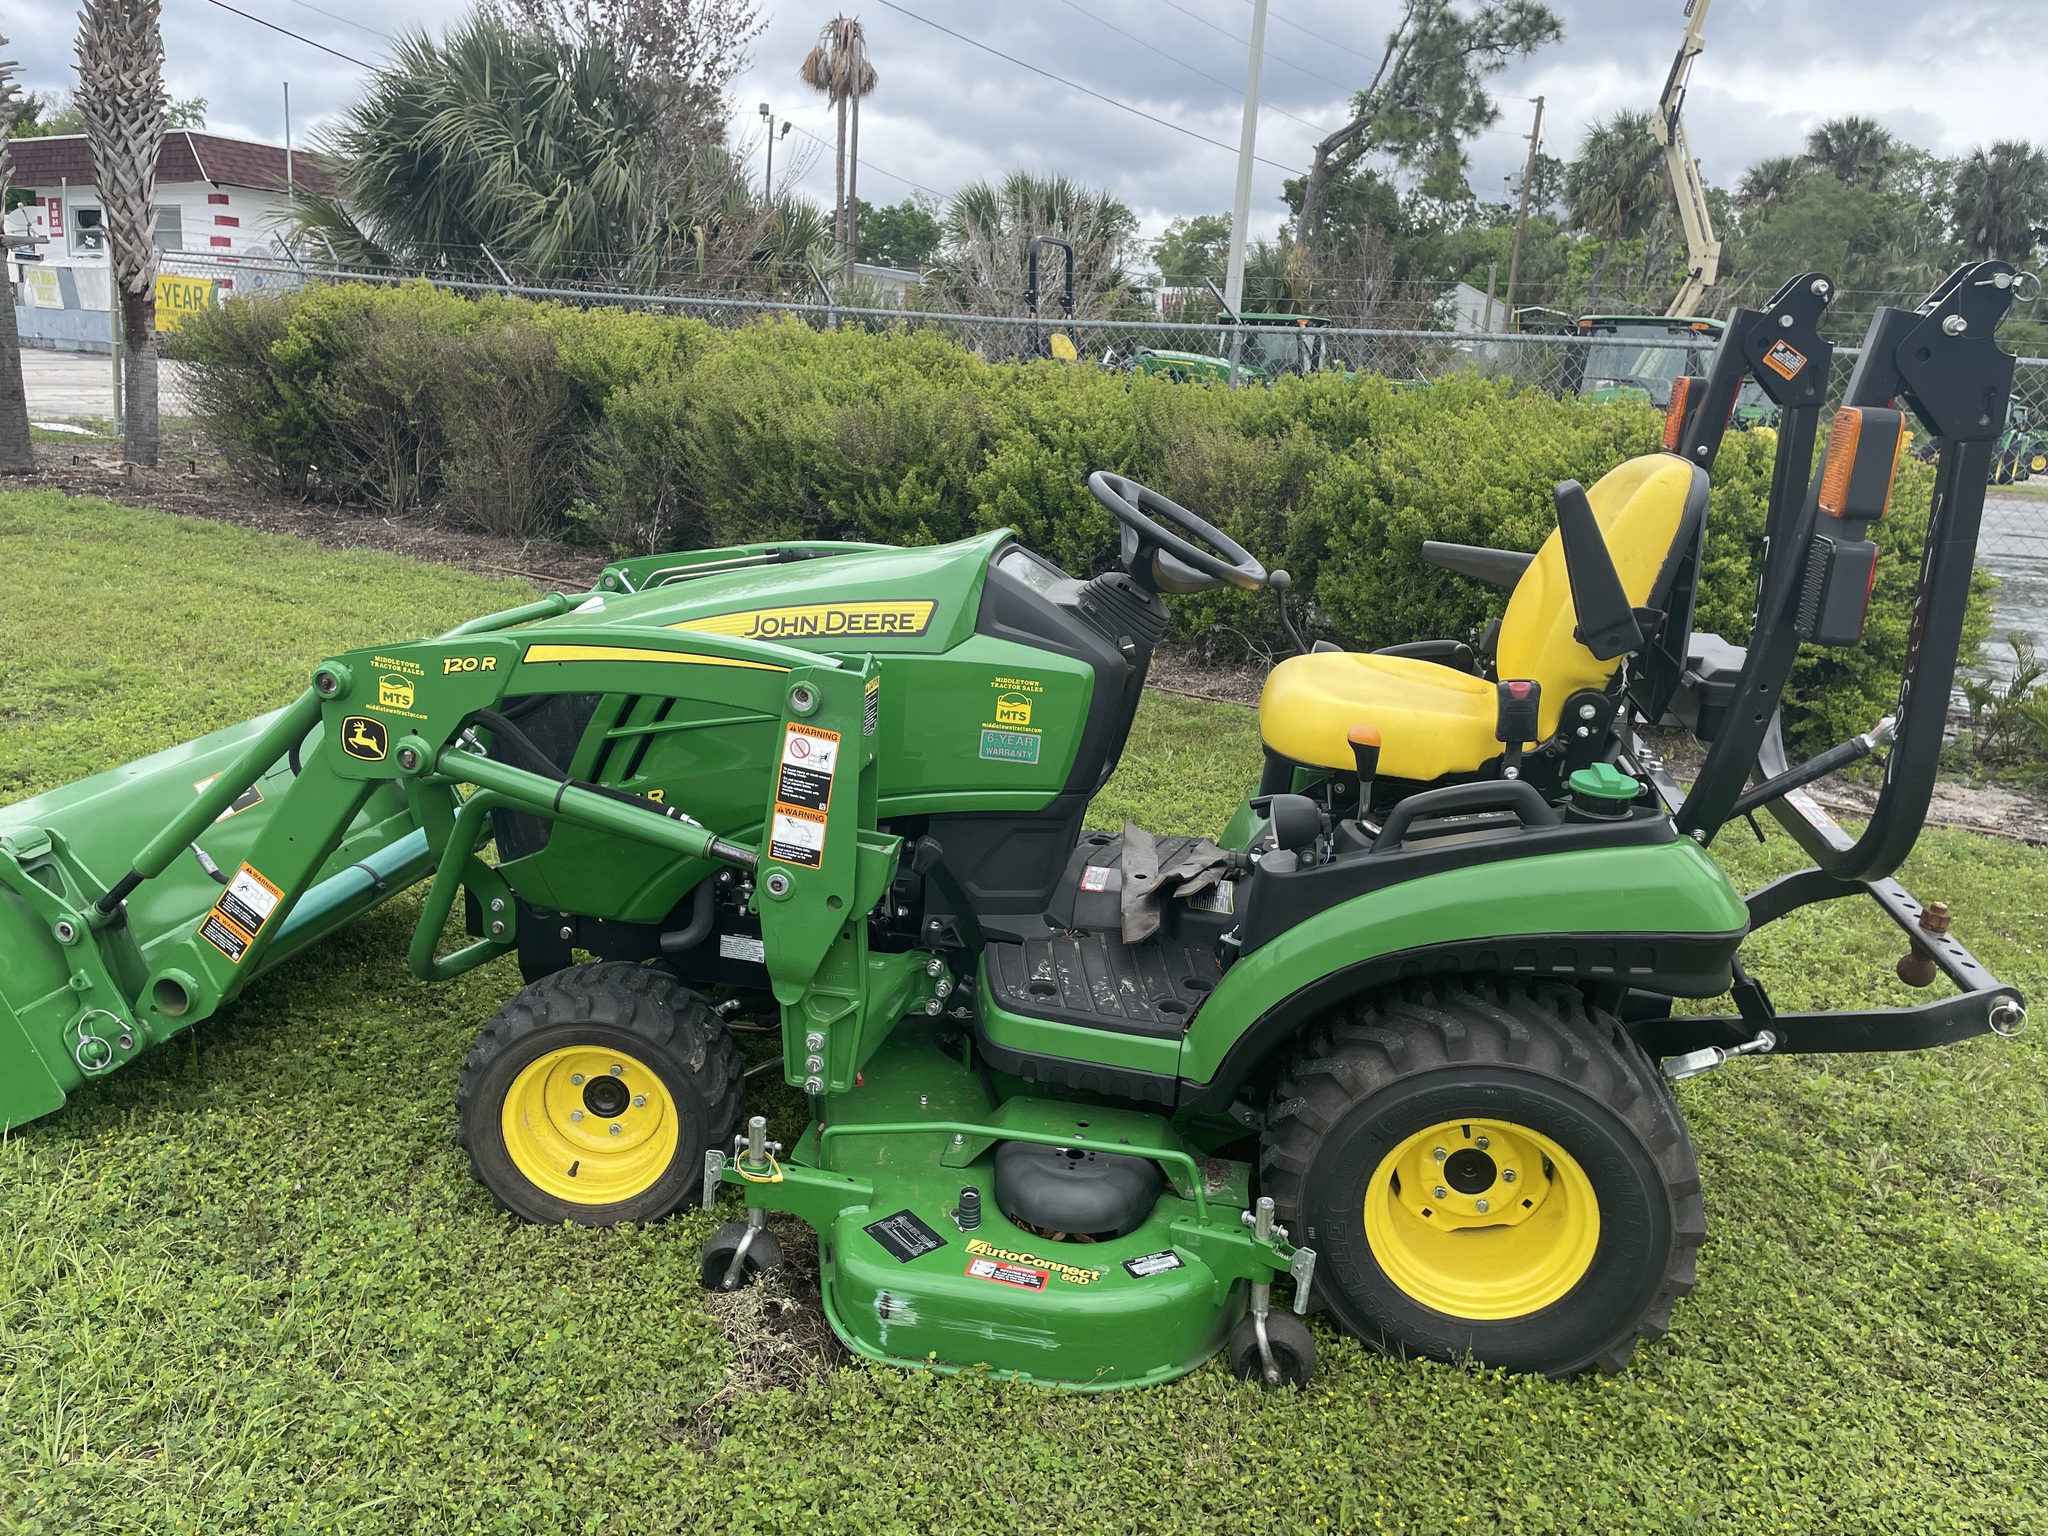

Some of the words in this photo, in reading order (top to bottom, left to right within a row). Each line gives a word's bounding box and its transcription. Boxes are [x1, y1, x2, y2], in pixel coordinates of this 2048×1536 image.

[744, 614, 819, 637] JOHN
[825, 611, 916, 633] DEERE
[370, 660, 402, 672] TRACTOR
[402, 666, 425, 676] SALES
[374, 655, 420, 669] MIDDLETOWN
[991, 682, 1020, 690] TRACTOR
[1022, 685, 1043, 693] SALES
[995, 677, 1040, 687] MIDDLETOWN
[383, 691, 411, 706] MTS
[365, 703, 428, 720] middletowntractor.com
[1000, 709, 1027, 721] MTS
[797, 725, 838, 741] WARNING
[987, 733, 1034, 747] 6-YEAR
[986, 747, 1033, 758] WARRANTY
[785, 807, 824, 823] WARNING
[253, 872, 279, 895] WARNING
[222, 917, 247, 942] WARNING
[966, 1239, 1101, 1281] AutoConnect
[1013, 1265, 1037, 1275] DANGER
[1060, 1272, 1091, 1285] 60D
[1325, 1219, 1454, 1358] CARLISLE
